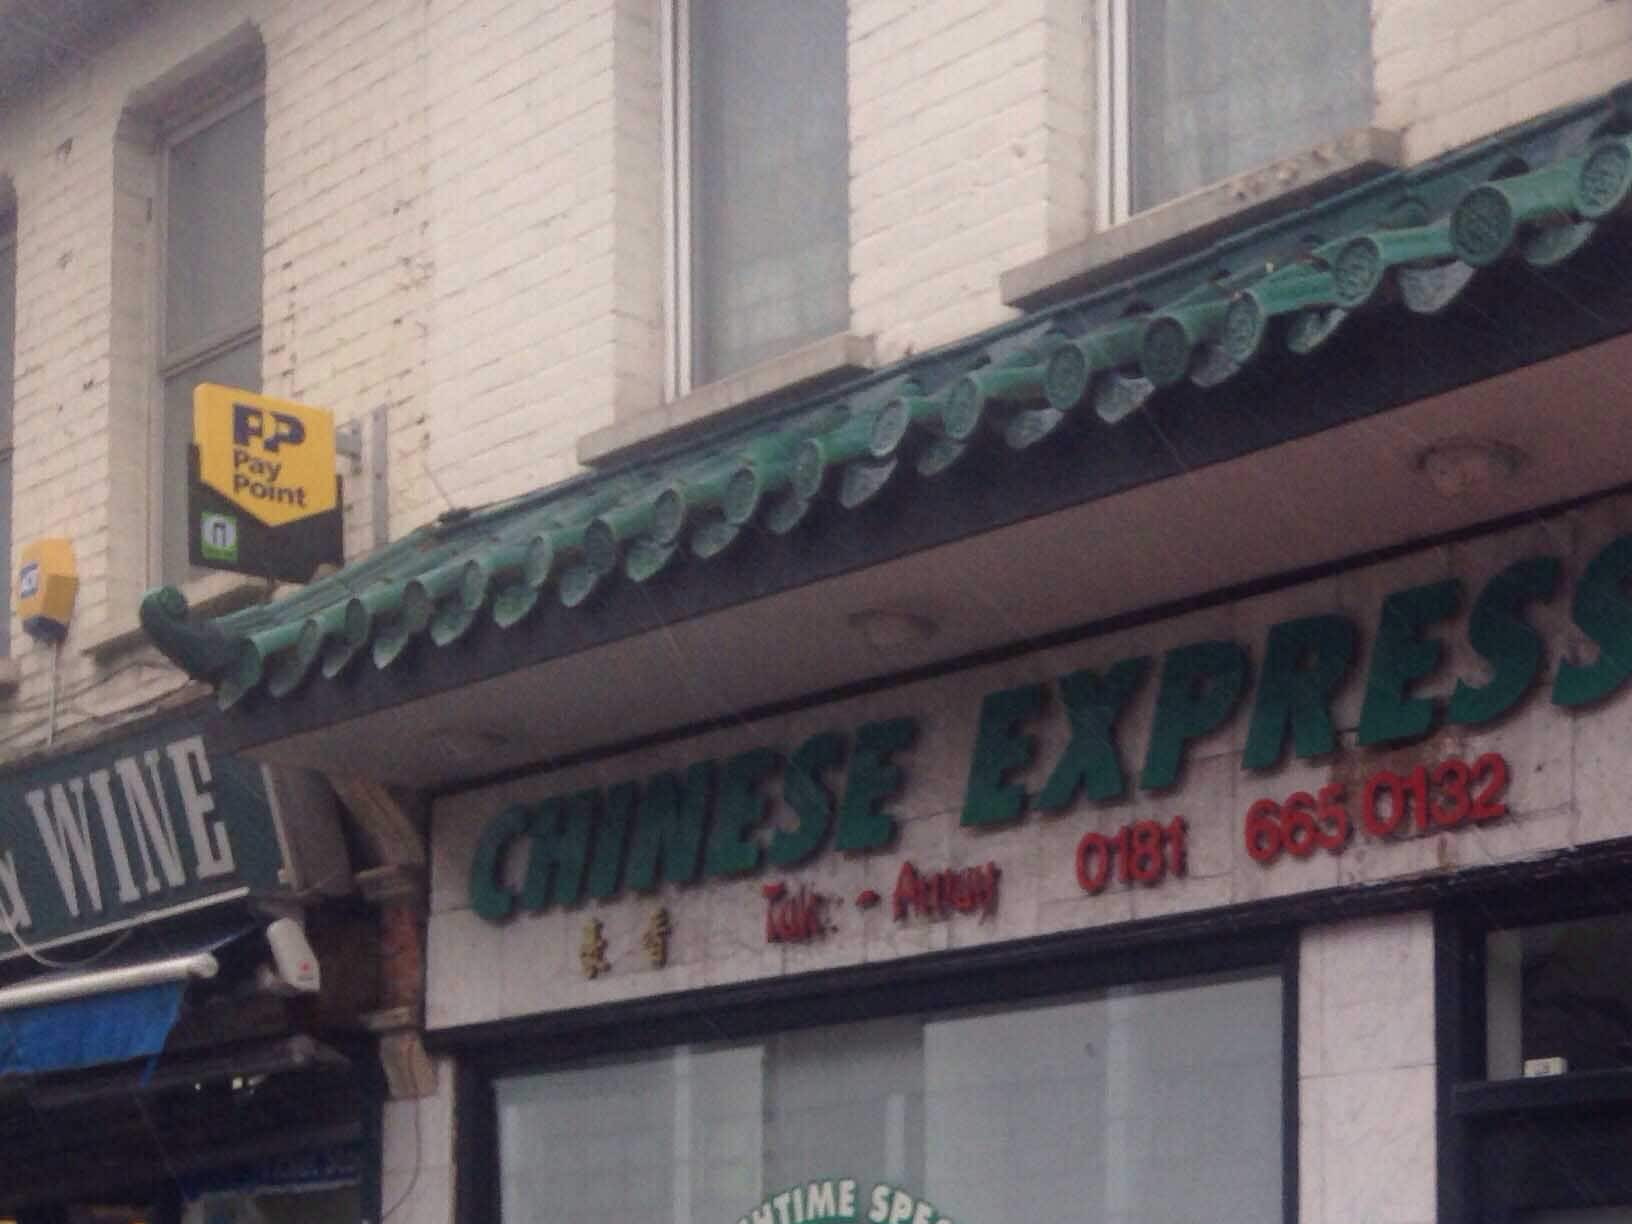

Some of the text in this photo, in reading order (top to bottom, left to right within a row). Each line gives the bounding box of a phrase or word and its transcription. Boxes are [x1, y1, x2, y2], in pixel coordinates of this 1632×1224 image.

[232, 448, 282, 482] Pay
[232, 473, 306, 508] Point
[26, 735, 235, 917] WINE
[469, 717, 918, 926] CHINESE
[892, 860, 1001, 926] Away
[1075, 815, 1188, 895] 0181
[1243, 783, 1352, 864] 665
[1362, 752, 1513, 838] 0132
